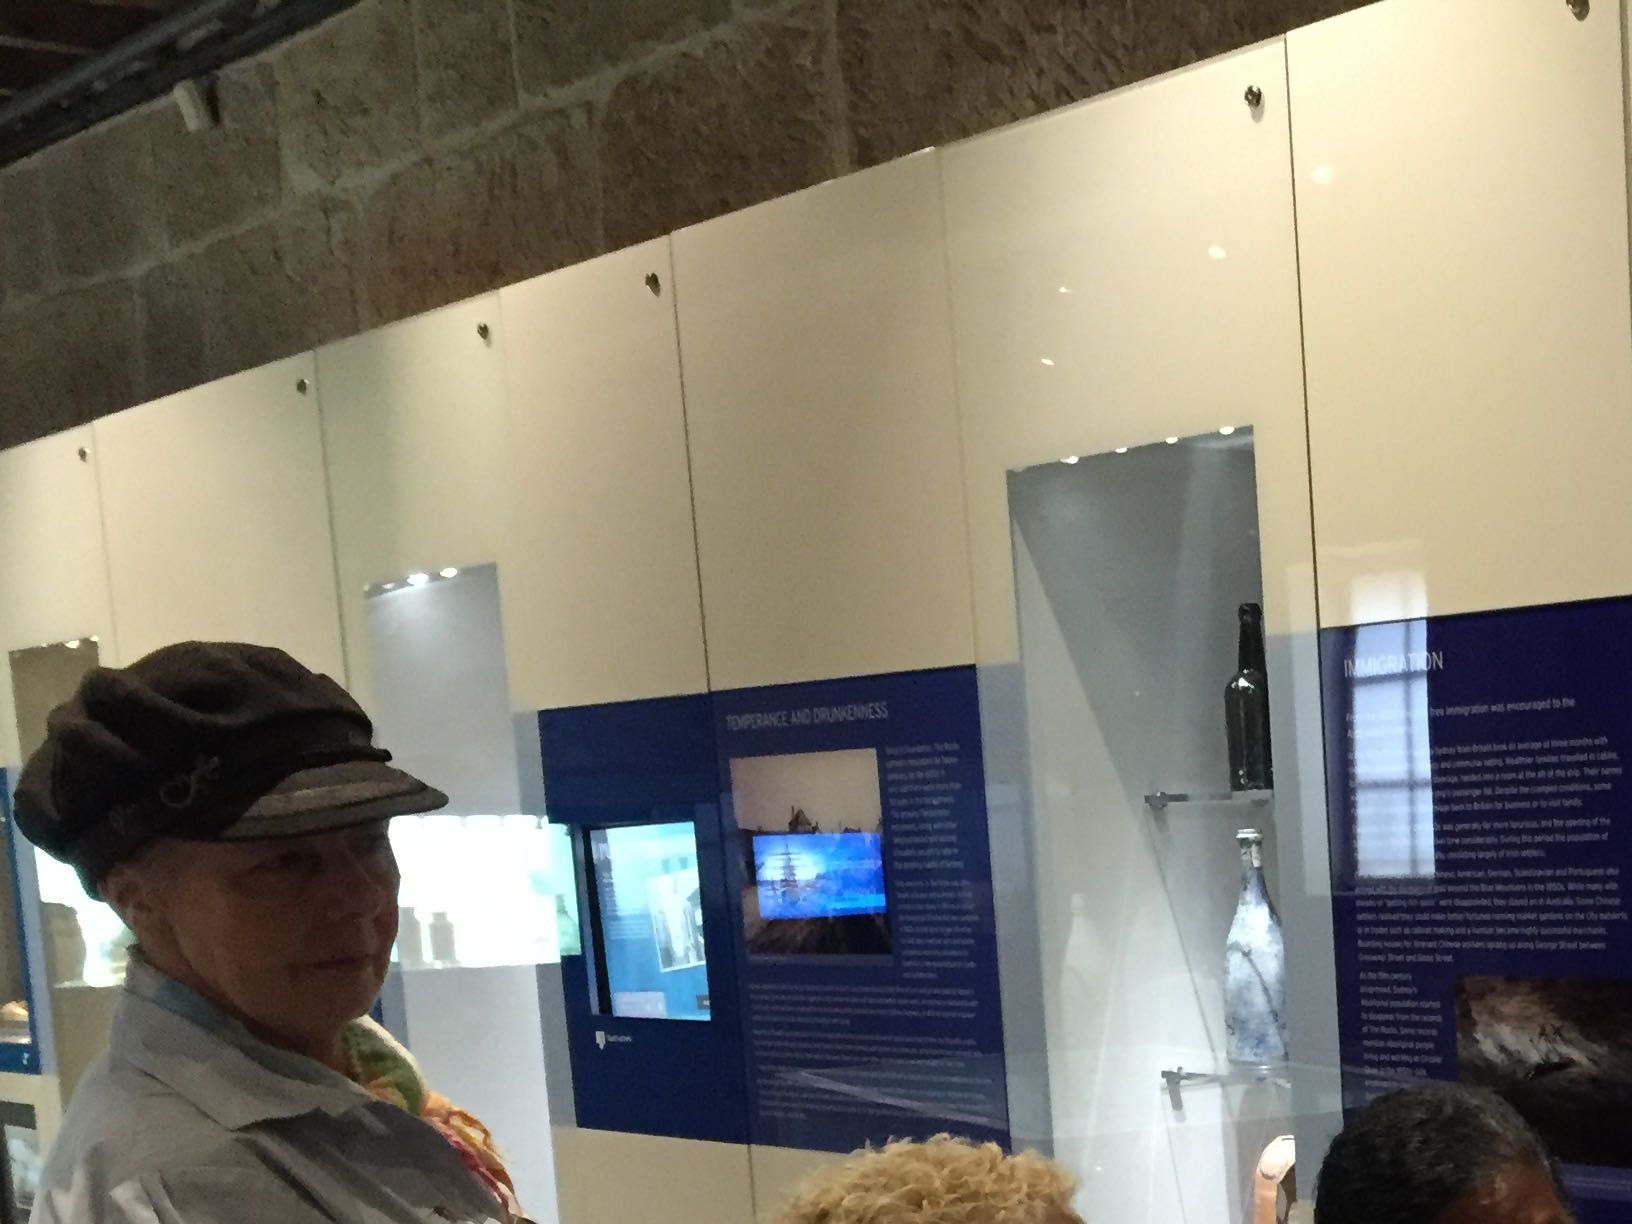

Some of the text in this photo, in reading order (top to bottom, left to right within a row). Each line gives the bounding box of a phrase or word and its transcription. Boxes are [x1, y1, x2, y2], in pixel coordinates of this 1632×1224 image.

[1343, 651, 1444, 678] IMMIGRATION
[726, 710, 789, 731] TEMPERANCE
[791, 708, 811, 725] AND
